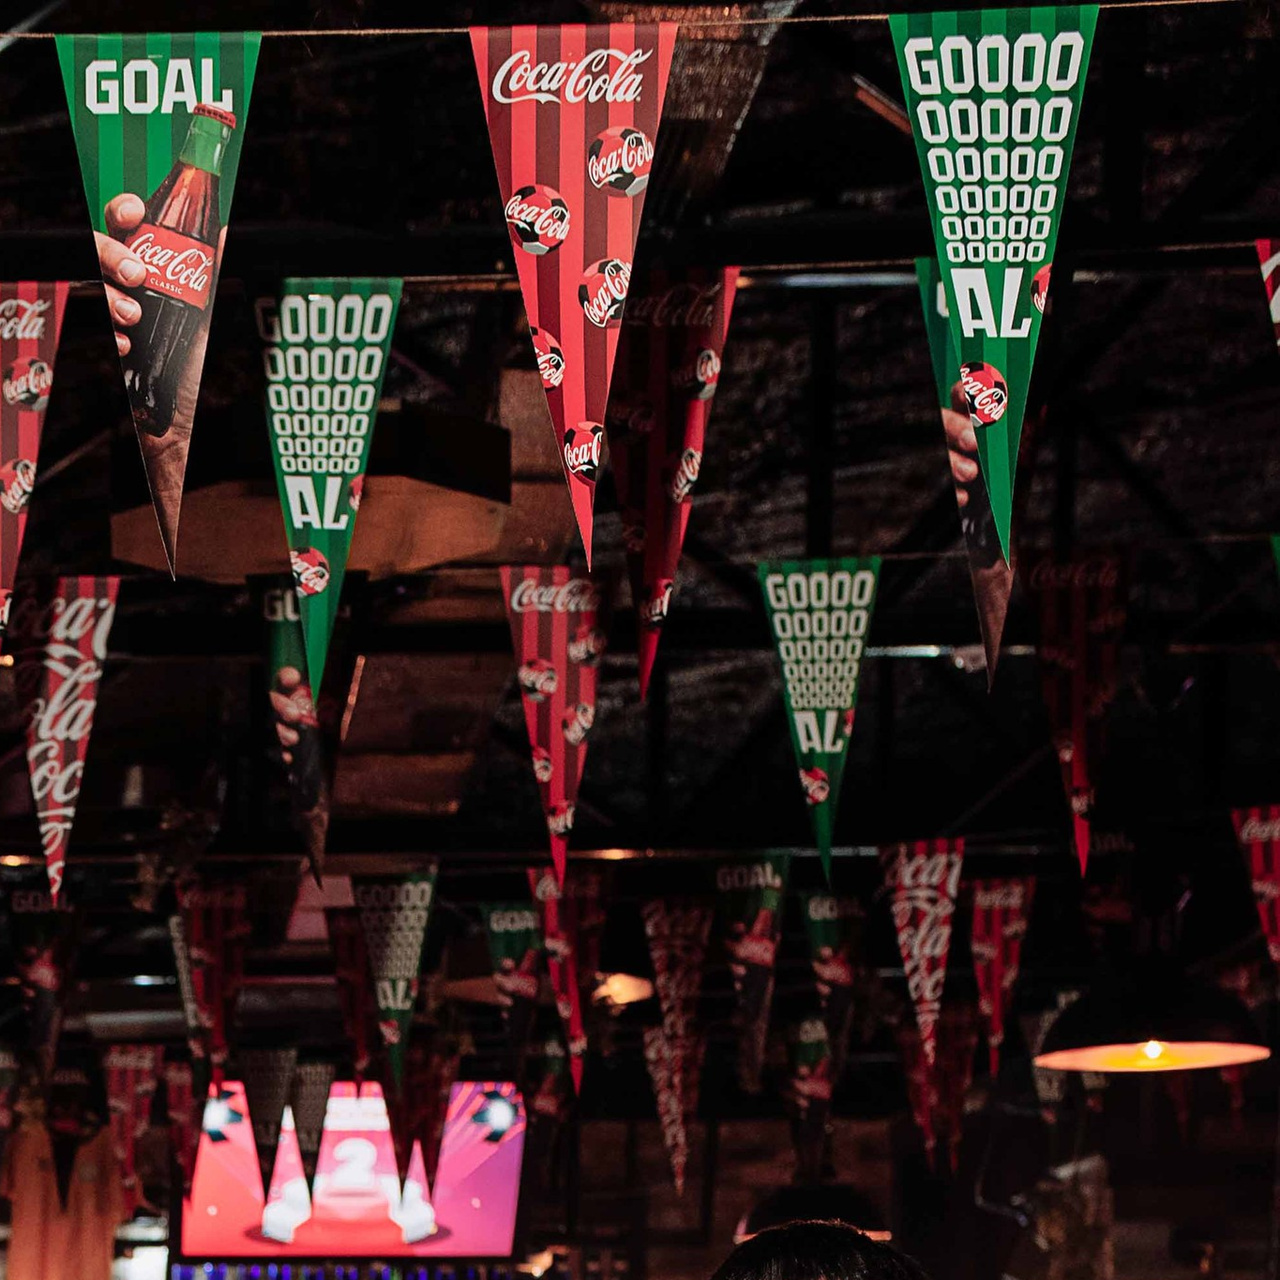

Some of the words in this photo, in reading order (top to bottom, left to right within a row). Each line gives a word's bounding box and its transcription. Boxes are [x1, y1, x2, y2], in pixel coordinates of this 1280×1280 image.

[492, 48, 653, 105] Coca-Cola
[904, 31, 1084, 95] GOOOO
[86, 58, 233, 114] GOAL
[917, 97, 1072, 143] OOOOO
[927, 146, 1064, 182] OOOOO
[935, 184, 1057, 214] OOOOO
[941, 215, 1051, 240] OOOOO
[946, 241, 1046, 263] OOOOO
[150, 277, 182, 294] CLASSIC
[950, 267, 1032, 338] AL
[284, 476, 349, 530] AL
[766, 570, 874, 610] GOOOO
[793, 710, 844, 754] AL
